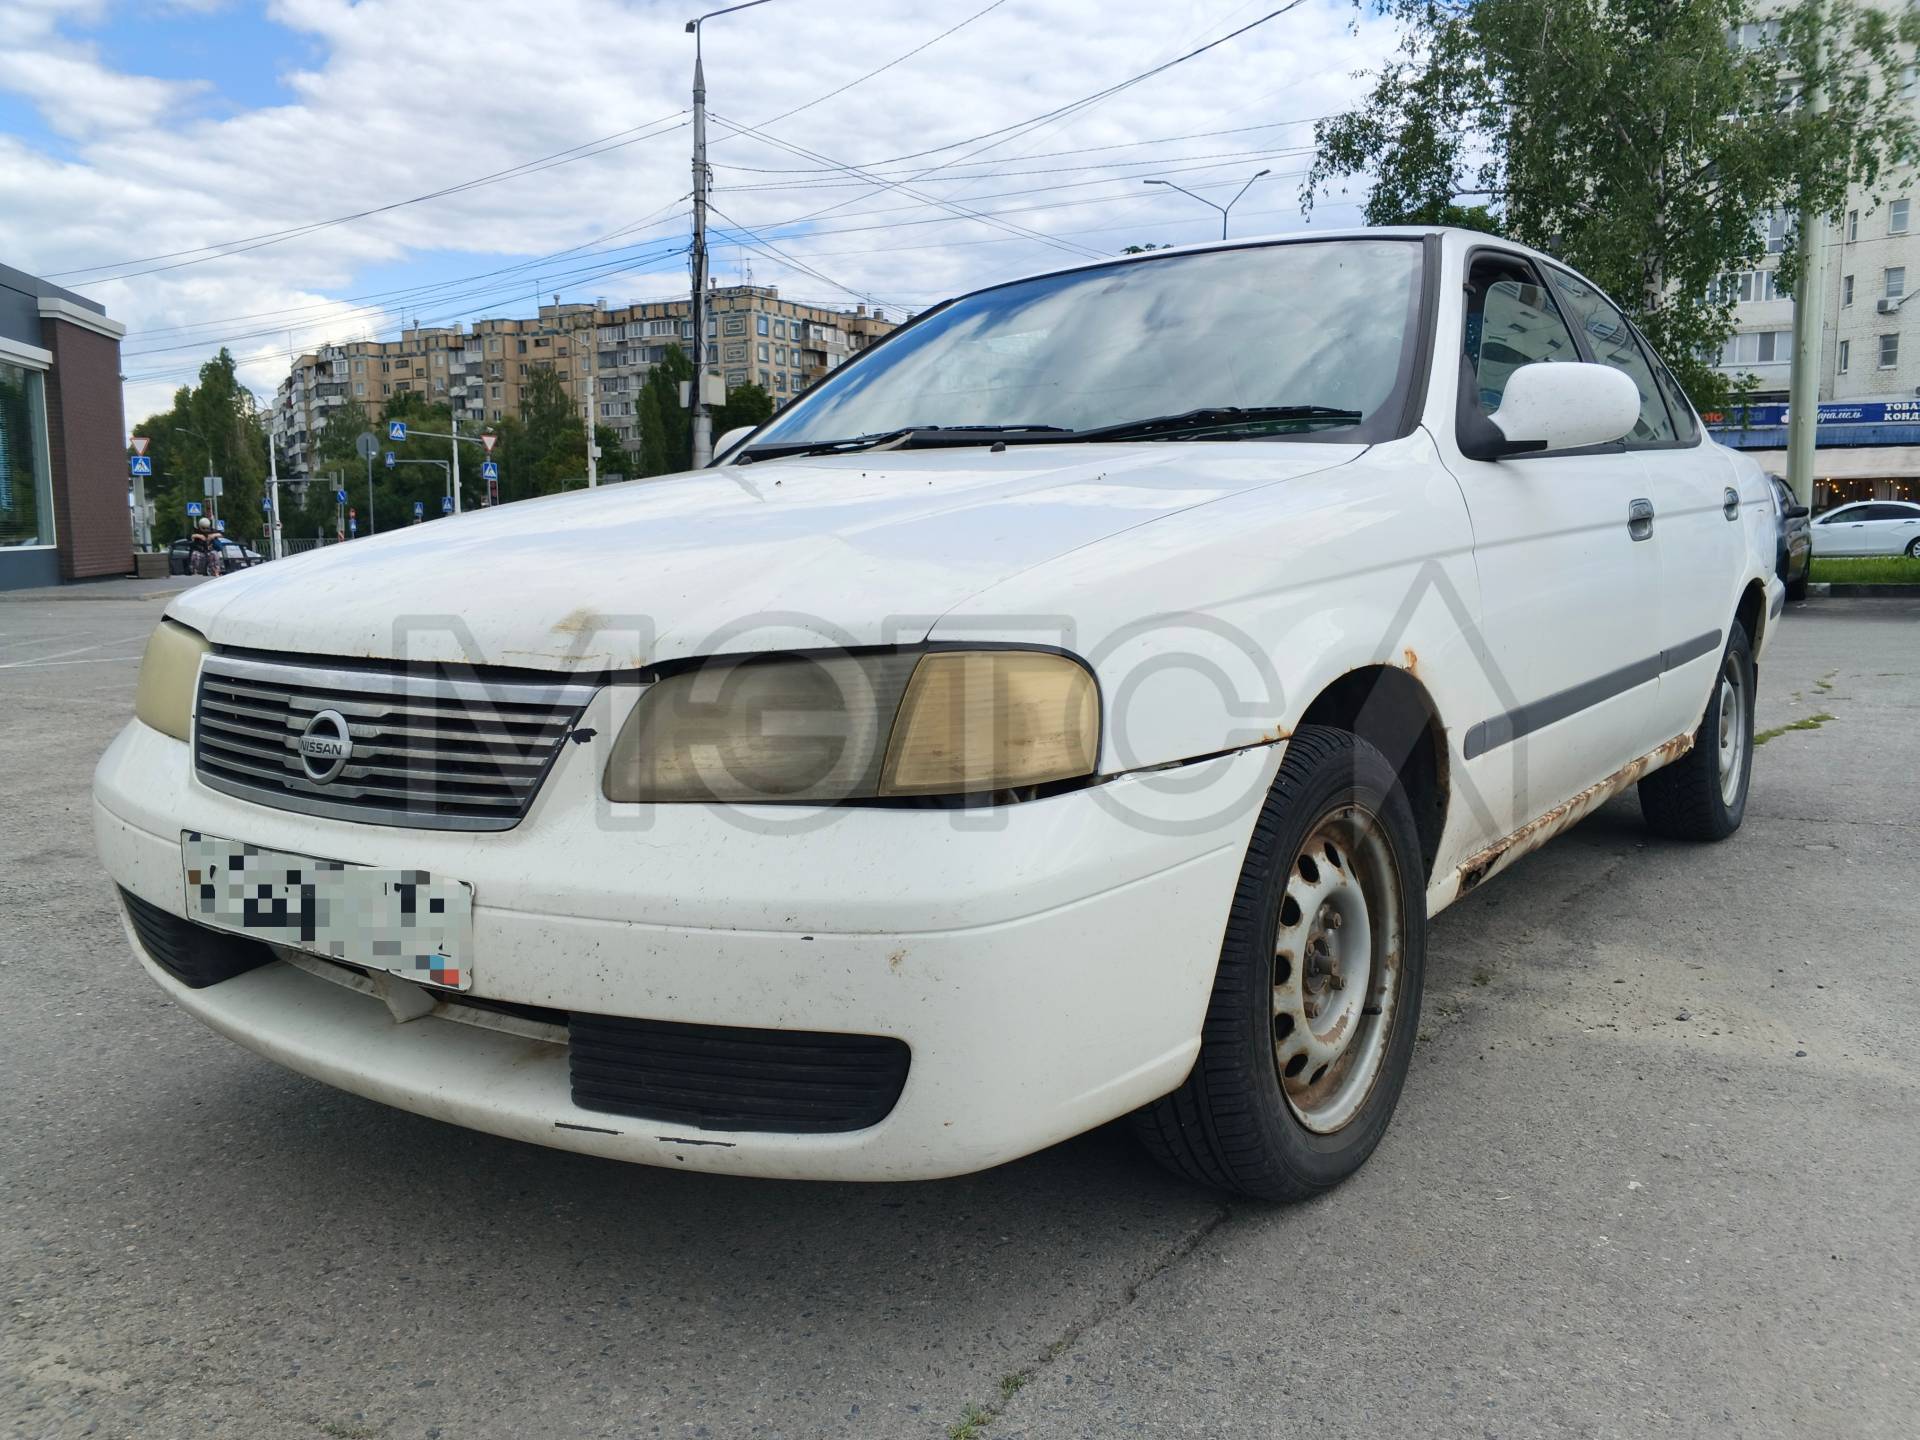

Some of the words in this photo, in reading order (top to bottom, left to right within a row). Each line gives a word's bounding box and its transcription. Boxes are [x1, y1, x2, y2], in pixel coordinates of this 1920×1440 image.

[1885, 402, 1920, 411] ТОВА
[1816, 409, 1863, 423] арамель
[300, 740, 342, 755] NISSAN
